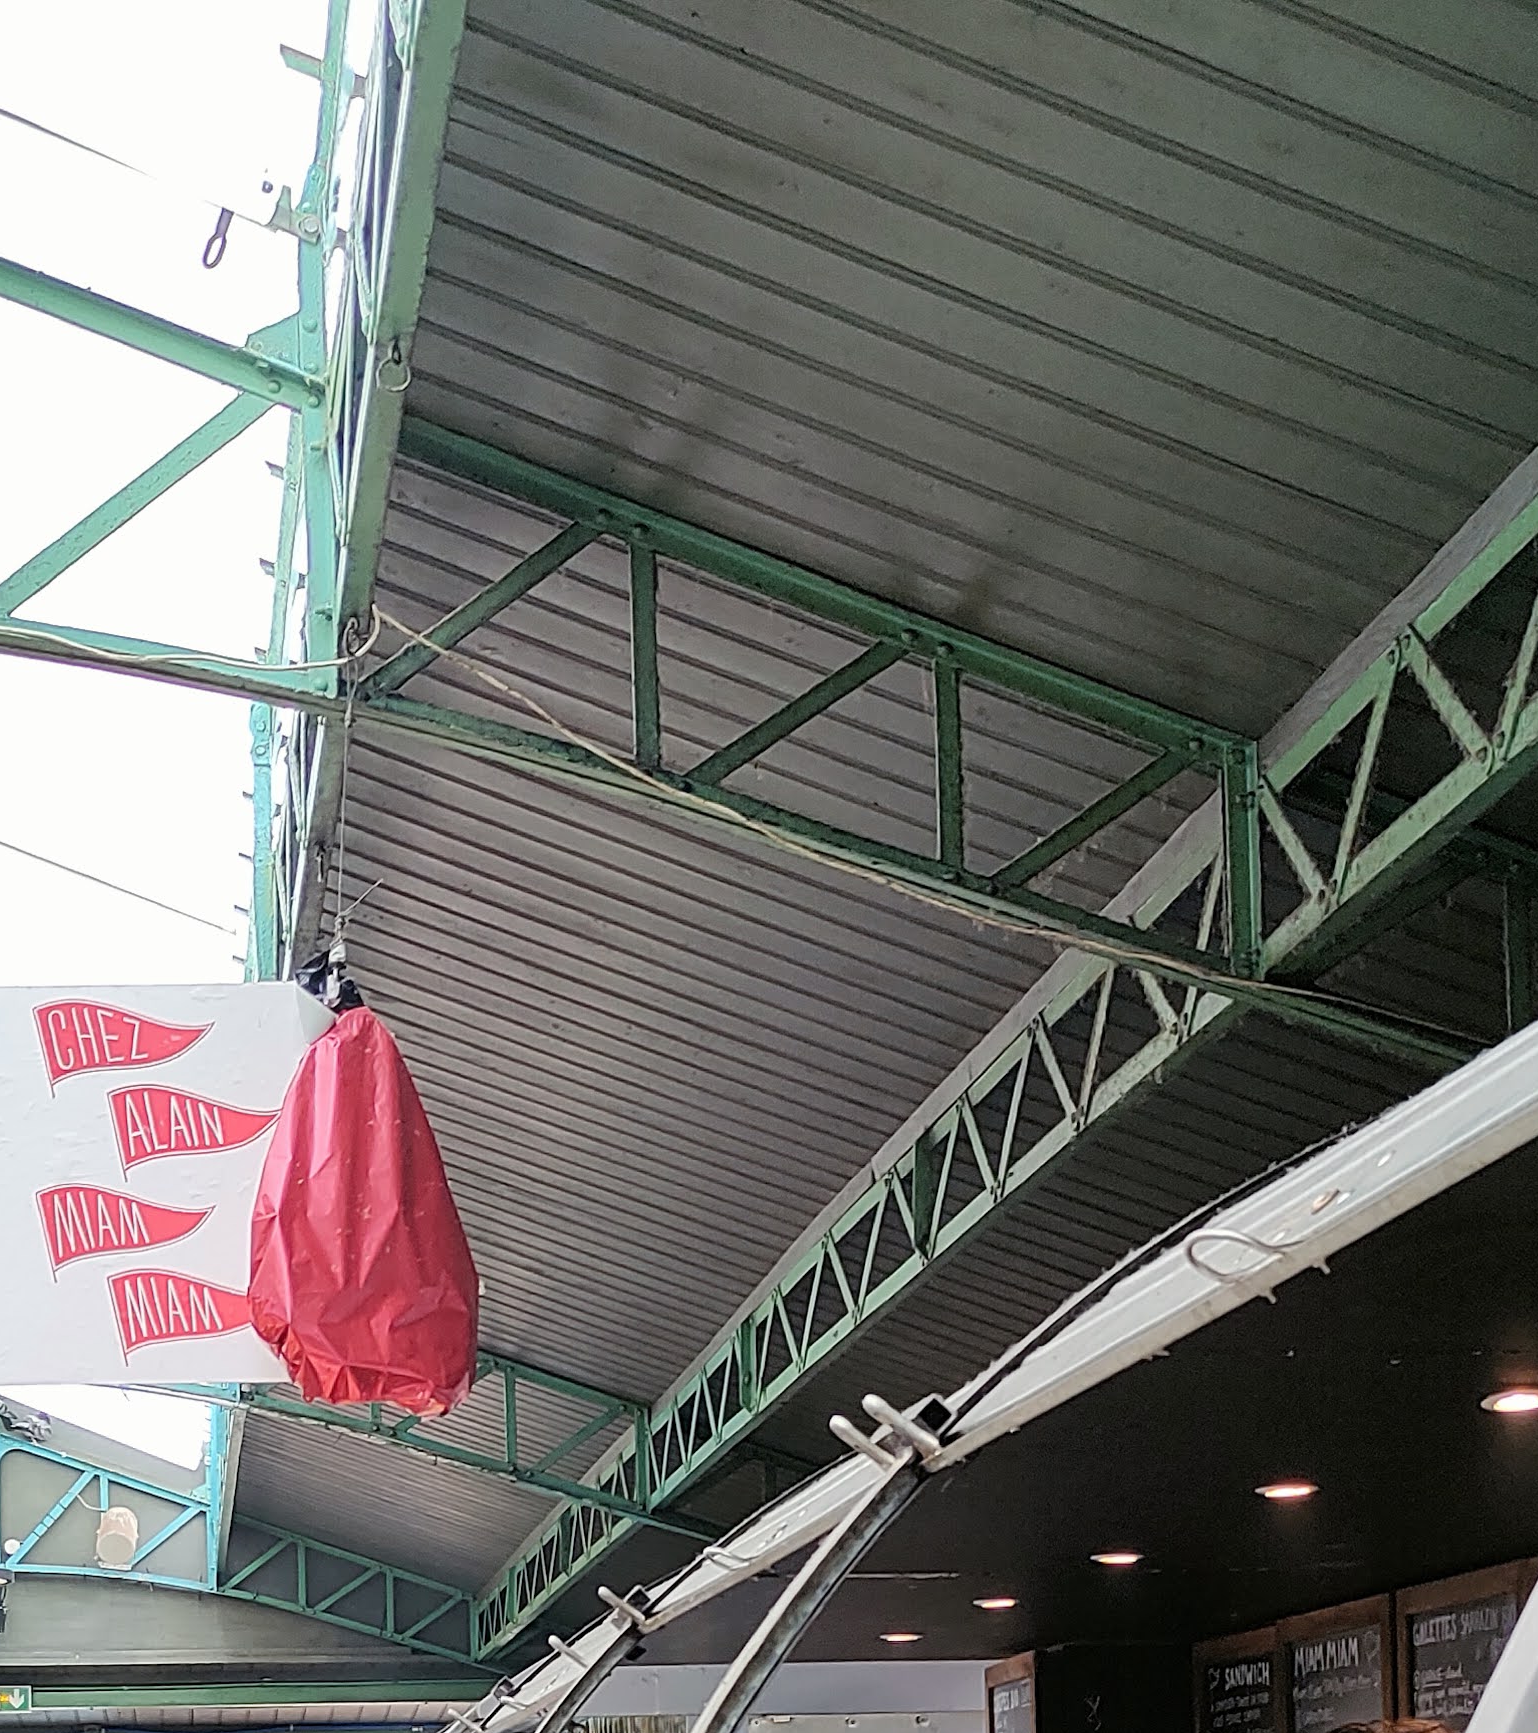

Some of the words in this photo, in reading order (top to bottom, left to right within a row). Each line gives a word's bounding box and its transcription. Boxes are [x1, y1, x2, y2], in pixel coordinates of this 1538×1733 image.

[47, 1006, 149, 1071] CHEZ
[124, 1091, 225, 1157] ALAIN
[53, 1190, 151, 1259] MIAM
[123, 1276, 224, 1343] MIAM
[1224, 1661, 1271, 1692] SANDWICH
